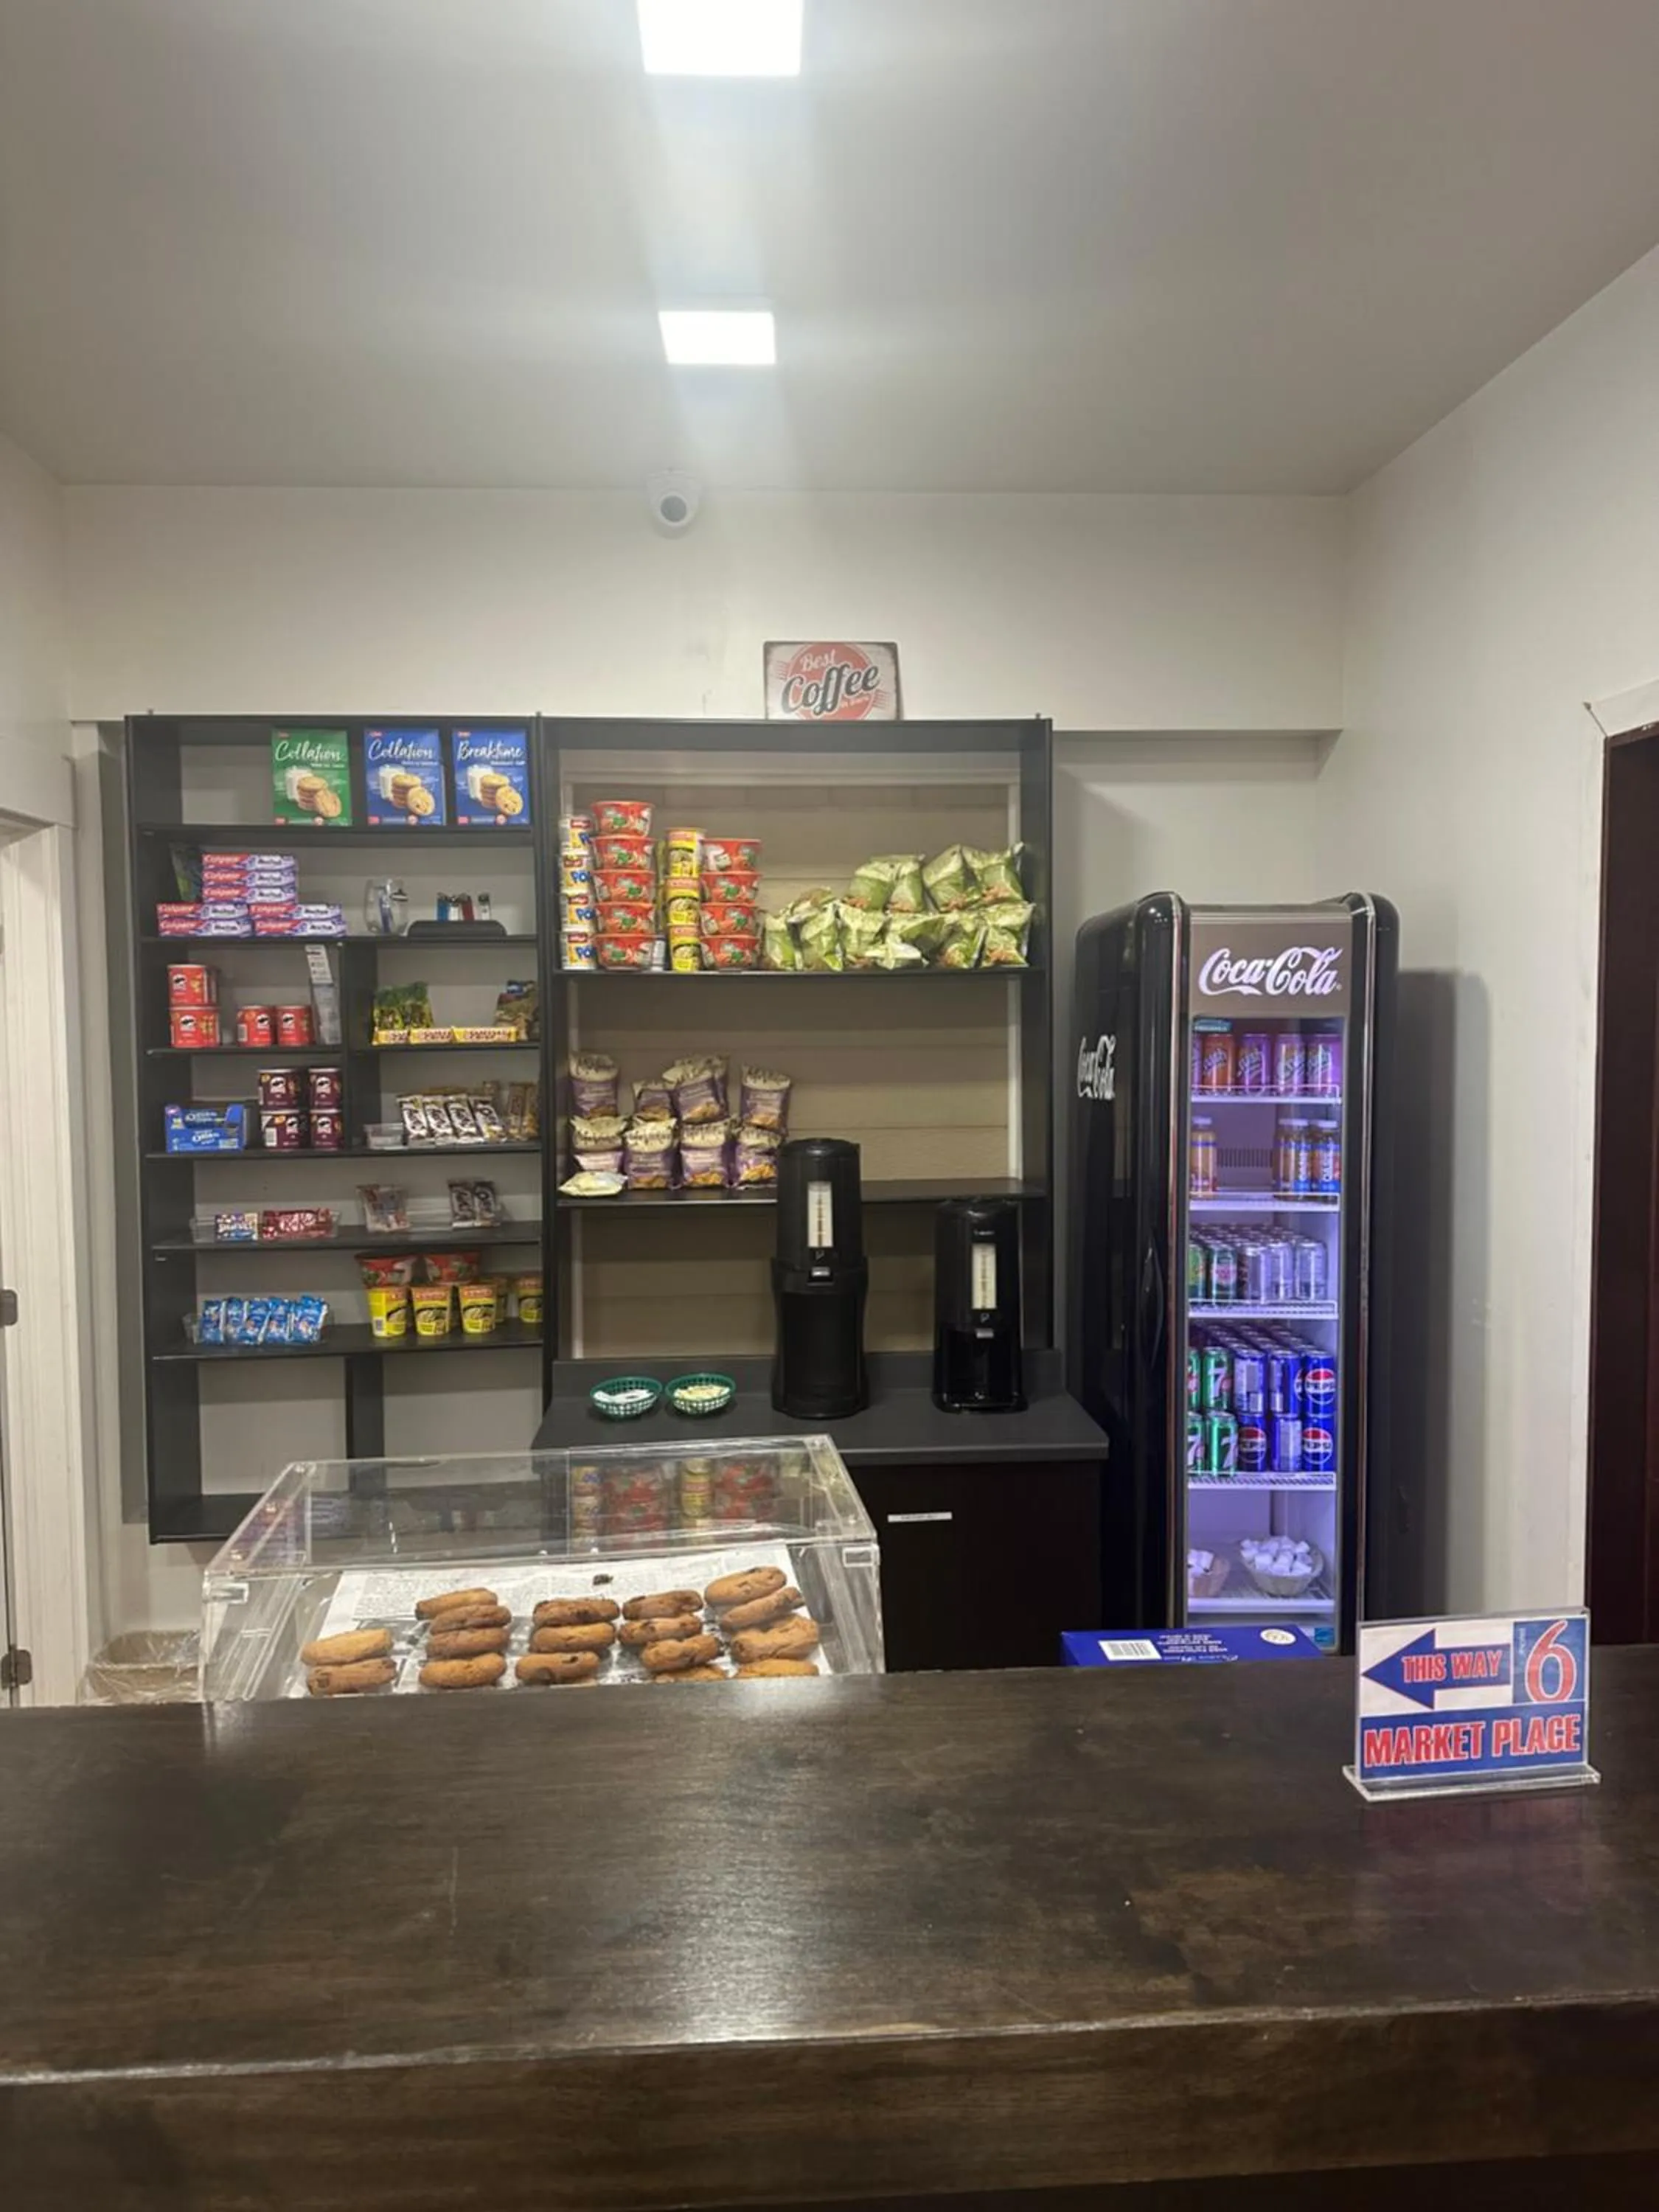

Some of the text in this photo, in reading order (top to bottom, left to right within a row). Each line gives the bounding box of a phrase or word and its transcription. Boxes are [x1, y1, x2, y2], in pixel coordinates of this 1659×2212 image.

[782, 663, 879, 715] Coffee
[1198, 947, 1343, 995] Coca-Cola
[1402, 1649, 1503, 1683] THIS WAY
[1525, 1619, 1577, 1703] 6
[1364, 1720, 1486, 1768] MARKET
[1492, 1714, 1580, 1757] PLACE
